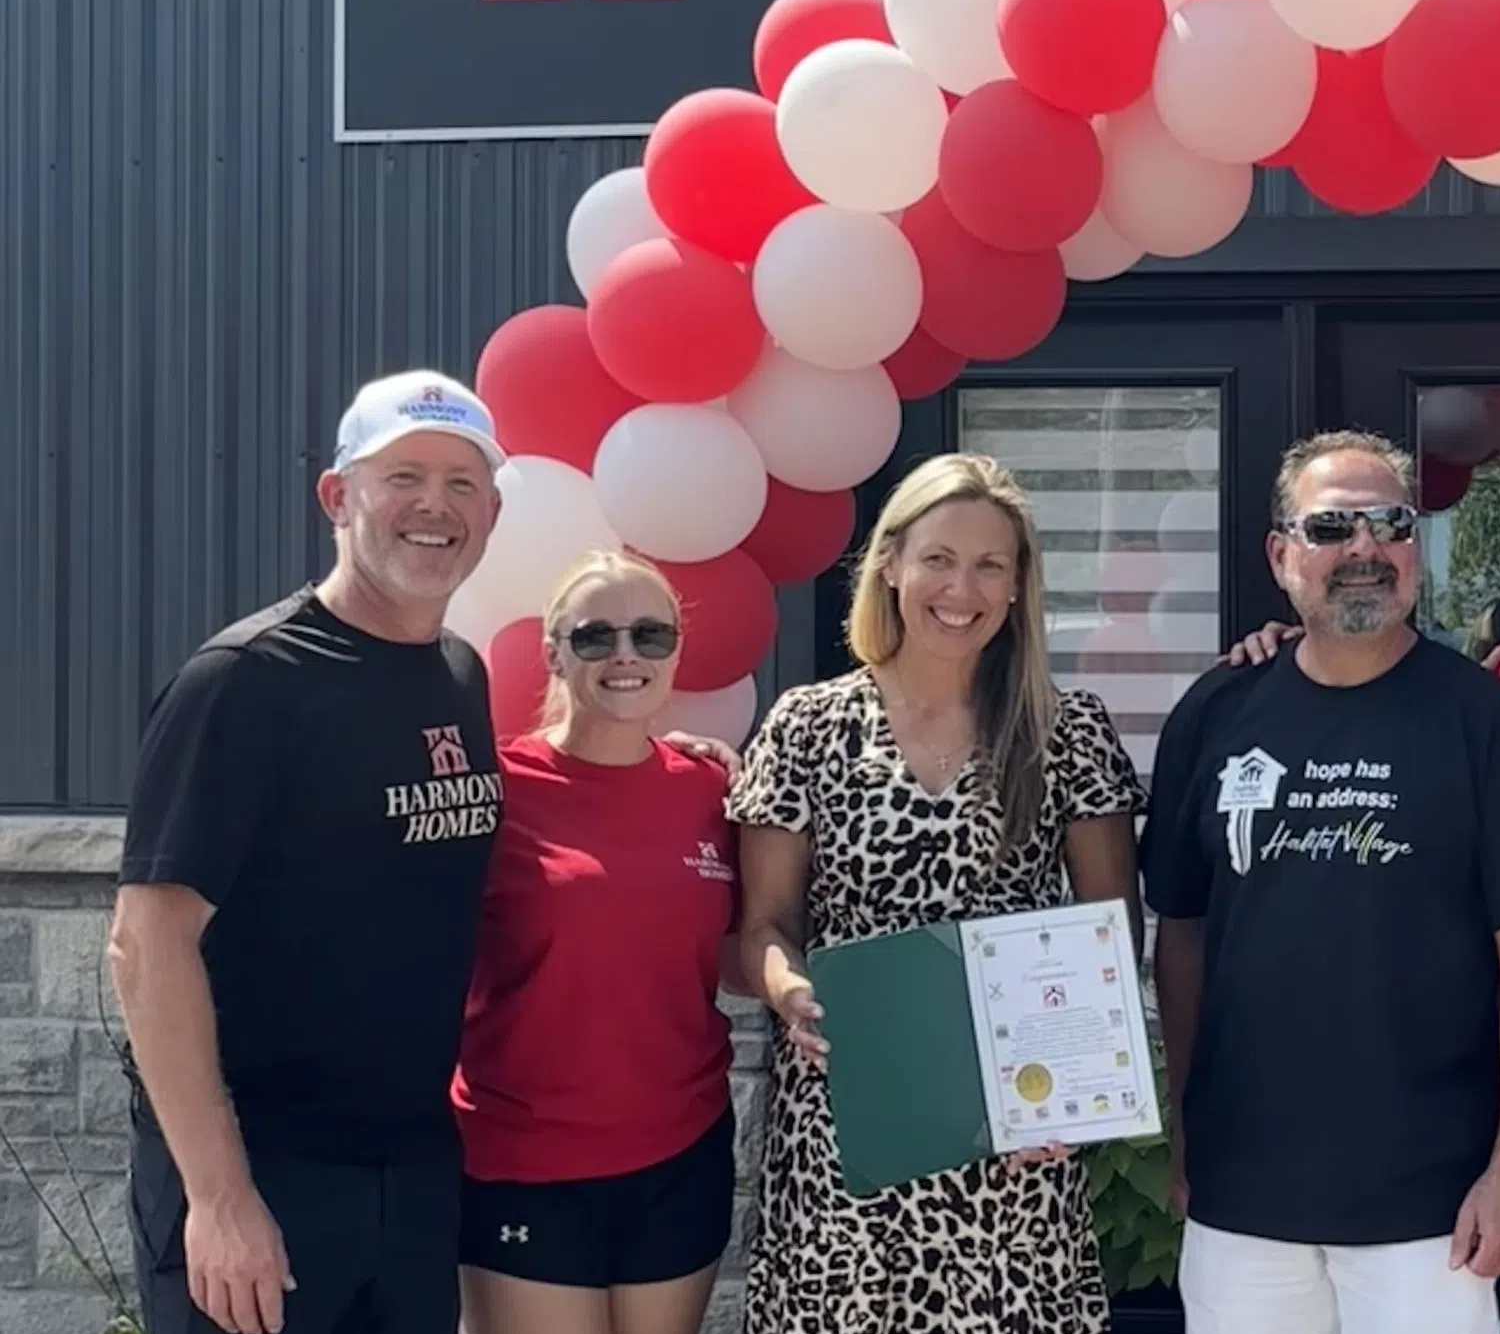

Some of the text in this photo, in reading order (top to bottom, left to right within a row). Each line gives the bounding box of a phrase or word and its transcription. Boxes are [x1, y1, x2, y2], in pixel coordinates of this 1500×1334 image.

[1304, 757, 1392, 783] hope has
[385, 772, 504, 817] HARMON
[1287, 791, 1313, 809] an
[1316, 786, 1399, 810] address:
[402, 804, 499, 843] HOMES
